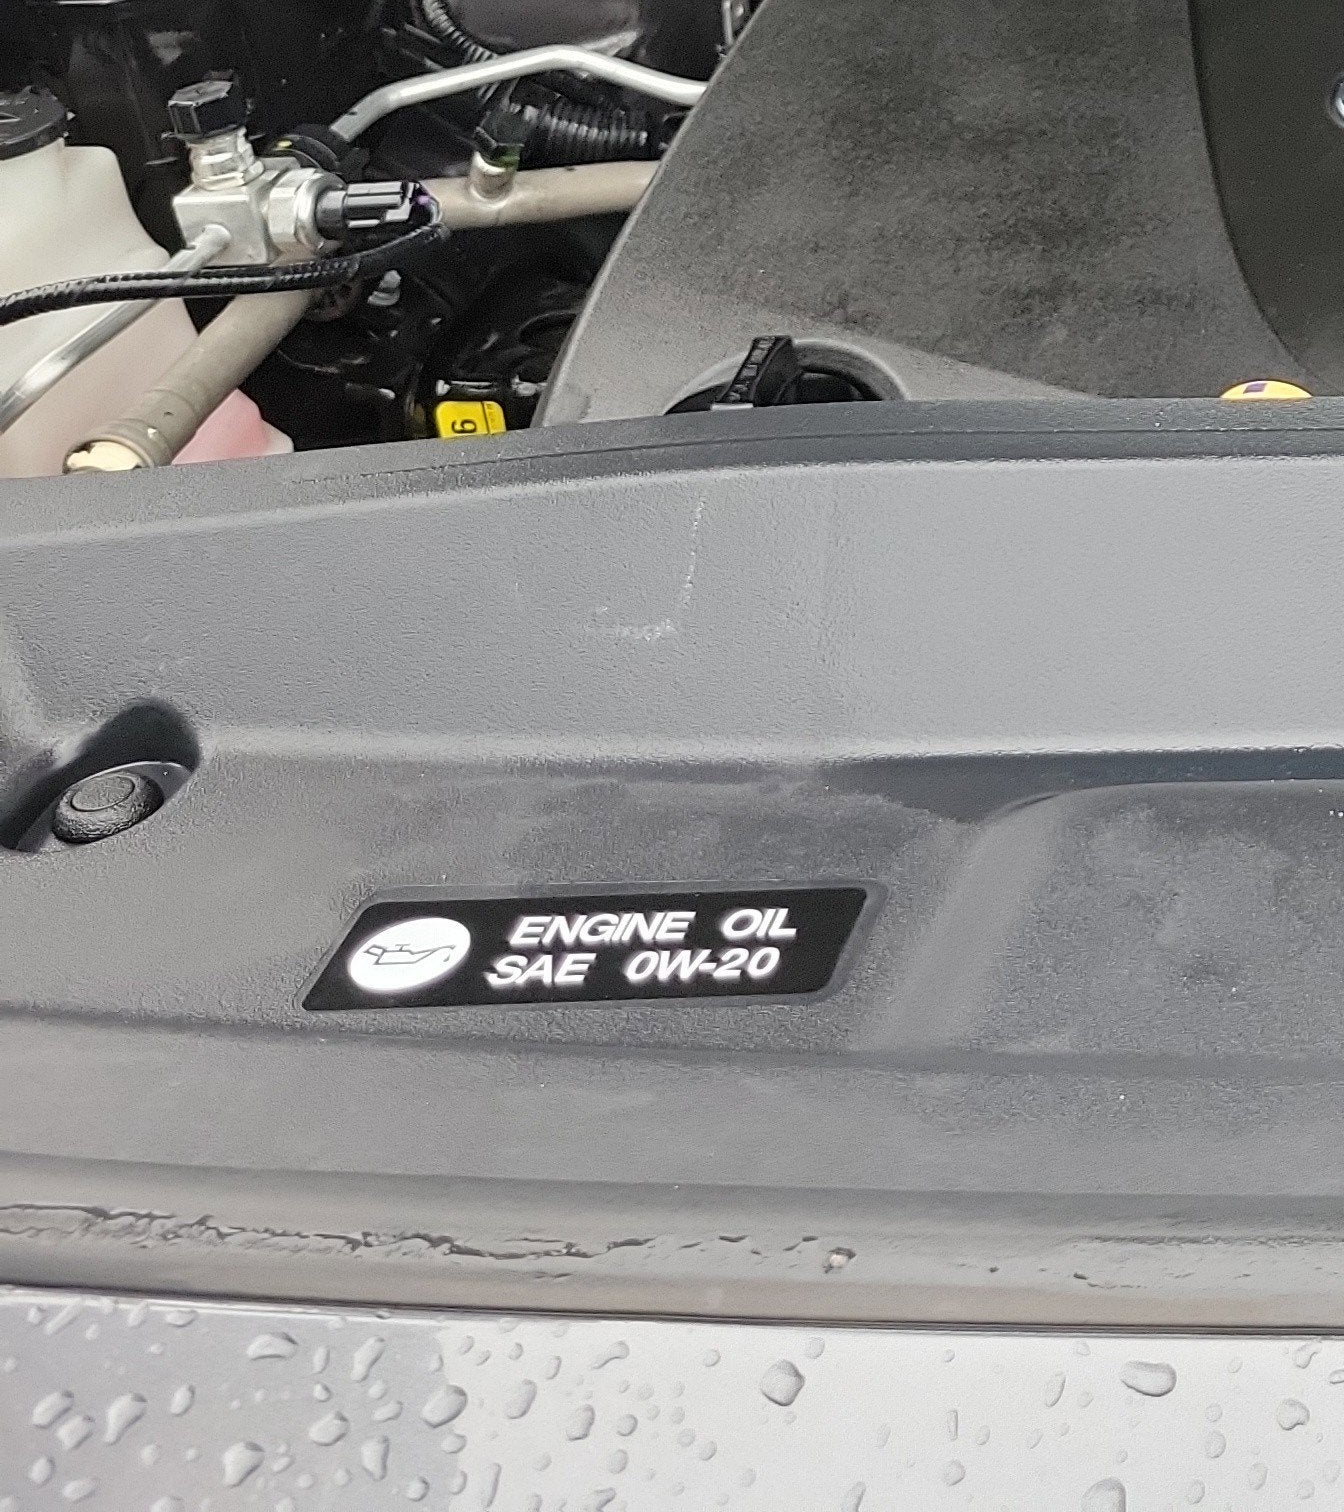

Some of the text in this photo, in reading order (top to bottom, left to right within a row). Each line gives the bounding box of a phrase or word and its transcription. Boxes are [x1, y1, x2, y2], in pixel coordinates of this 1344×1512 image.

[508, 907, 798, 946] ENGINE OIL
[484, 945, 782, 986] SAE 0W-20
